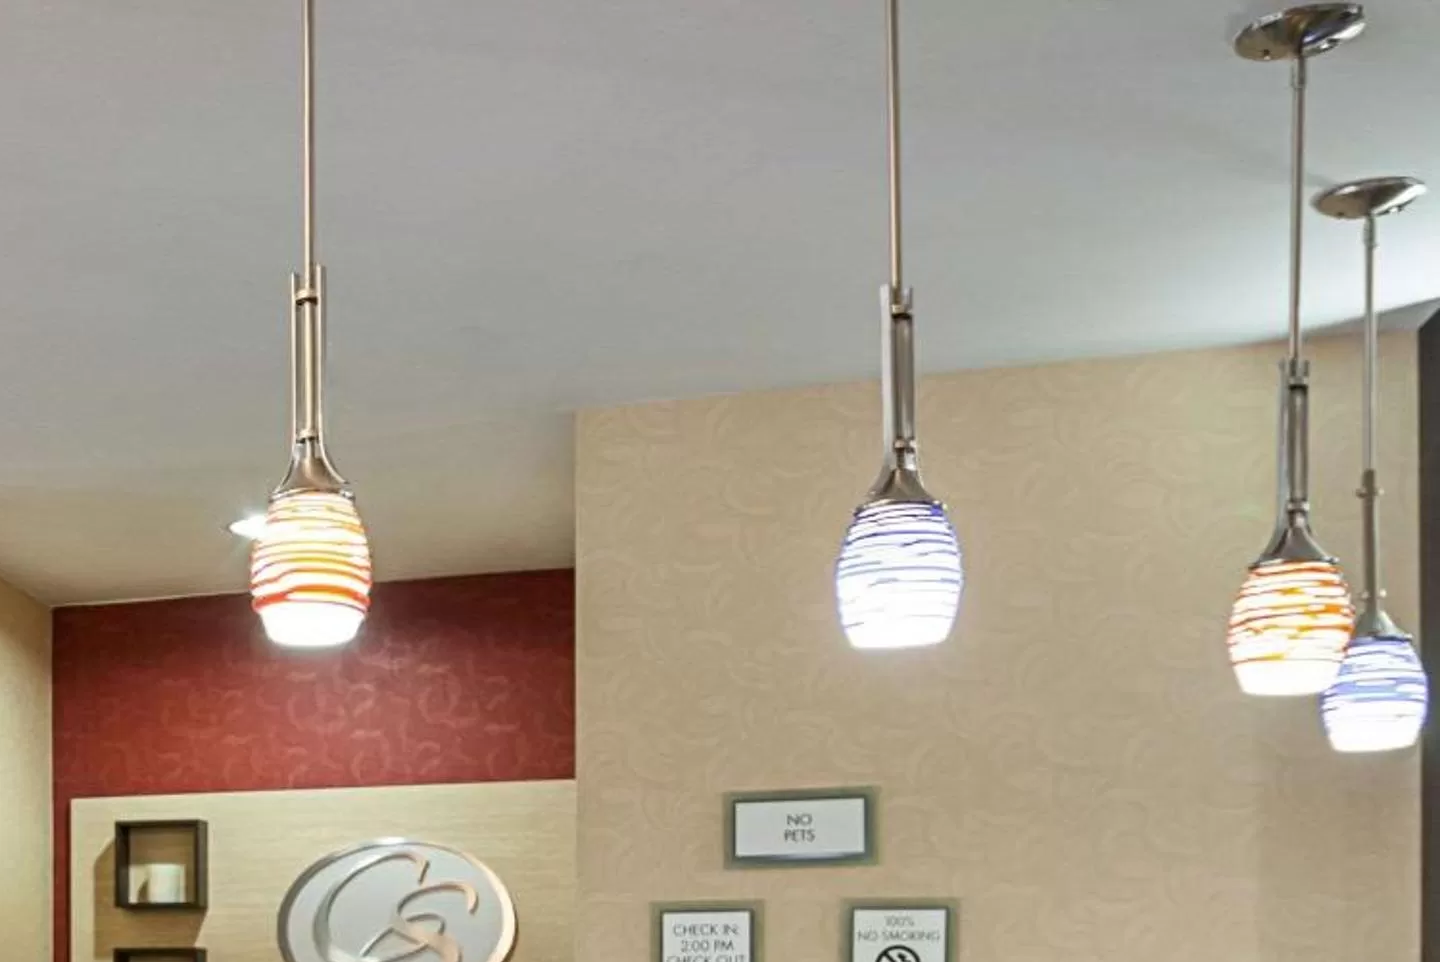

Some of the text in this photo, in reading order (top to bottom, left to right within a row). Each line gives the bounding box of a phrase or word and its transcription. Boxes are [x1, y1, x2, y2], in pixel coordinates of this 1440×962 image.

[787, 813, 813, 826] NO
[784, 829, 816, 843] PETS
[673, 923, 718, 937] CHECK
[857, 929, 941, 942] NO SMOKING
[713, 939, 735, 953] PM
